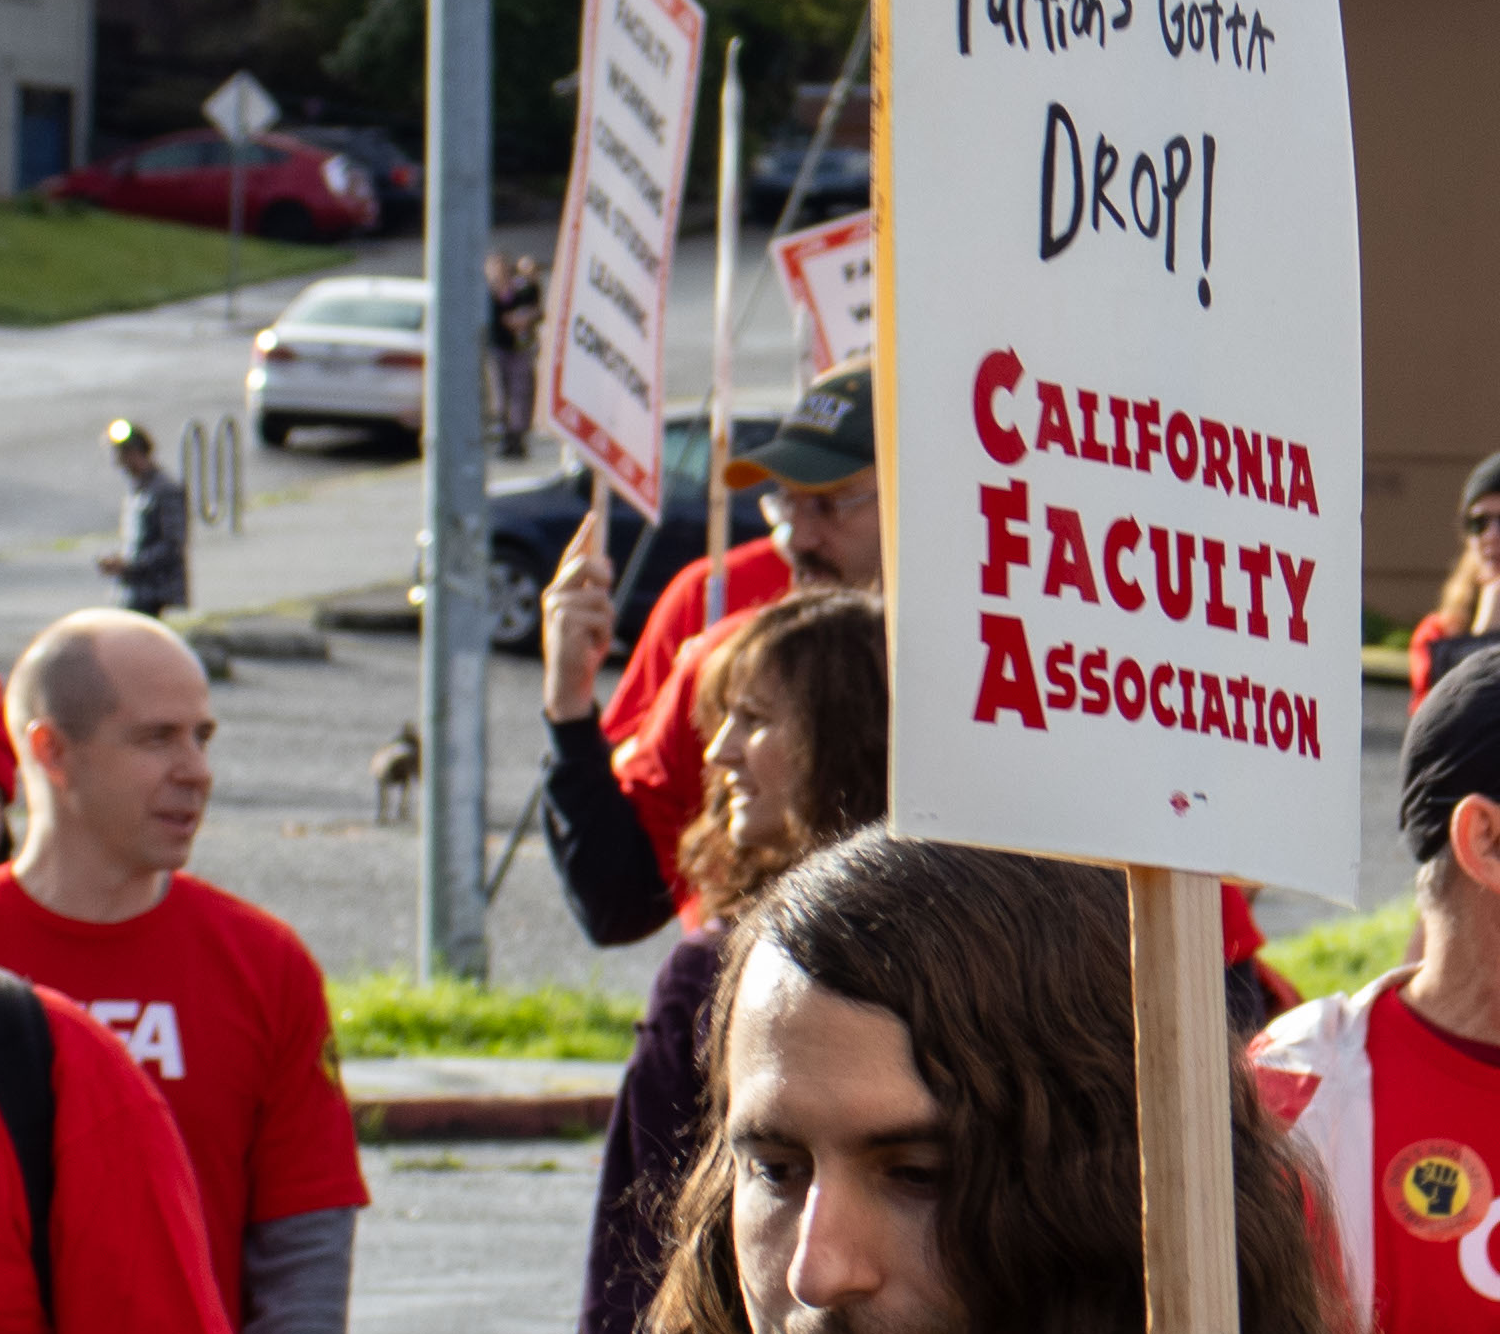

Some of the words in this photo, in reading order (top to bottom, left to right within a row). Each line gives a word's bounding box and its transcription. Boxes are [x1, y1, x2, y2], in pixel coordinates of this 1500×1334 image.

[1039, 100, 1217, 310] DROP!
[971, 343, 1320, 517] CALIFORNIA
[978, 476, 1316, 646] FACULTY
[971, 609, 1322, 762] ASSOCIATION
[75, 998, 187, 1081] FA
